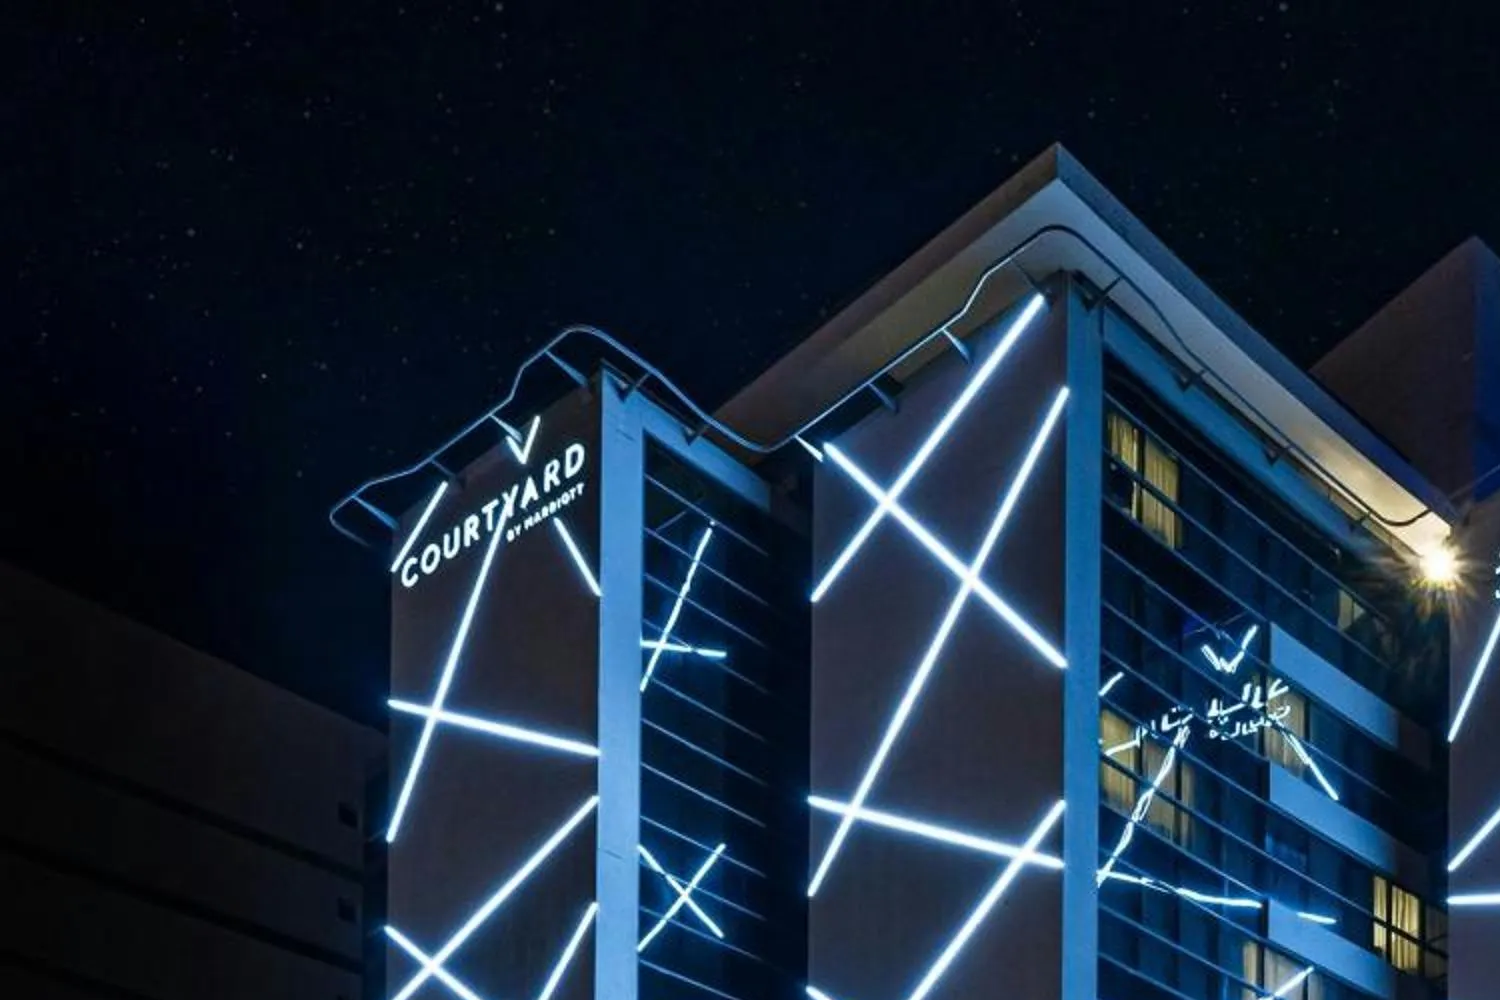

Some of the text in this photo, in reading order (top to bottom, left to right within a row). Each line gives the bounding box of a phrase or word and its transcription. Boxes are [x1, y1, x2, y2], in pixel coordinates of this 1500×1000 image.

[401, 443, 585, 588] COURTYARD
[506, 482, 585, 542] BY MARRIOTT
